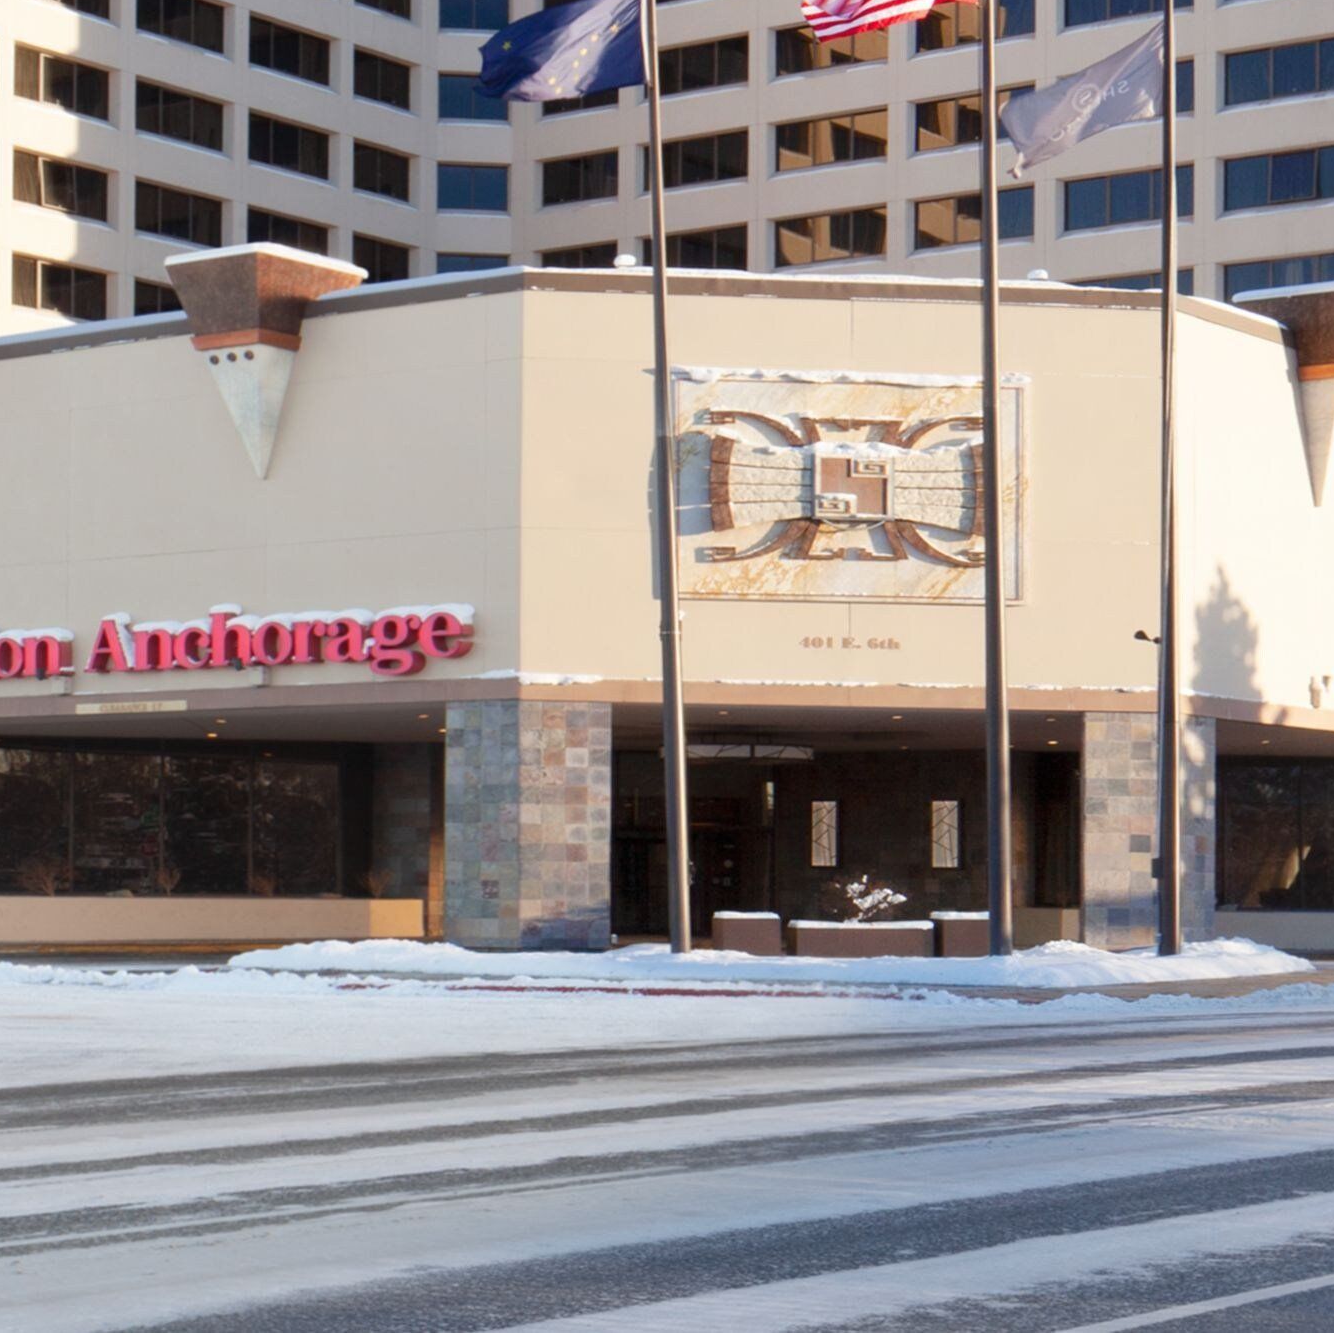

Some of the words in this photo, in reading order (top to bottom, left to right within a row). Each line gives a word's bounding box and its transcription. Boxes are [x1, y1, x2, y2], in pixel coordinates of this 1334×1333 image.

[84, 611, 473, 676] Anchorage
[799, 636, 833, 648] 401
[841, 636, 861, 648] E.
[867, 637, 901, 649] 6th
